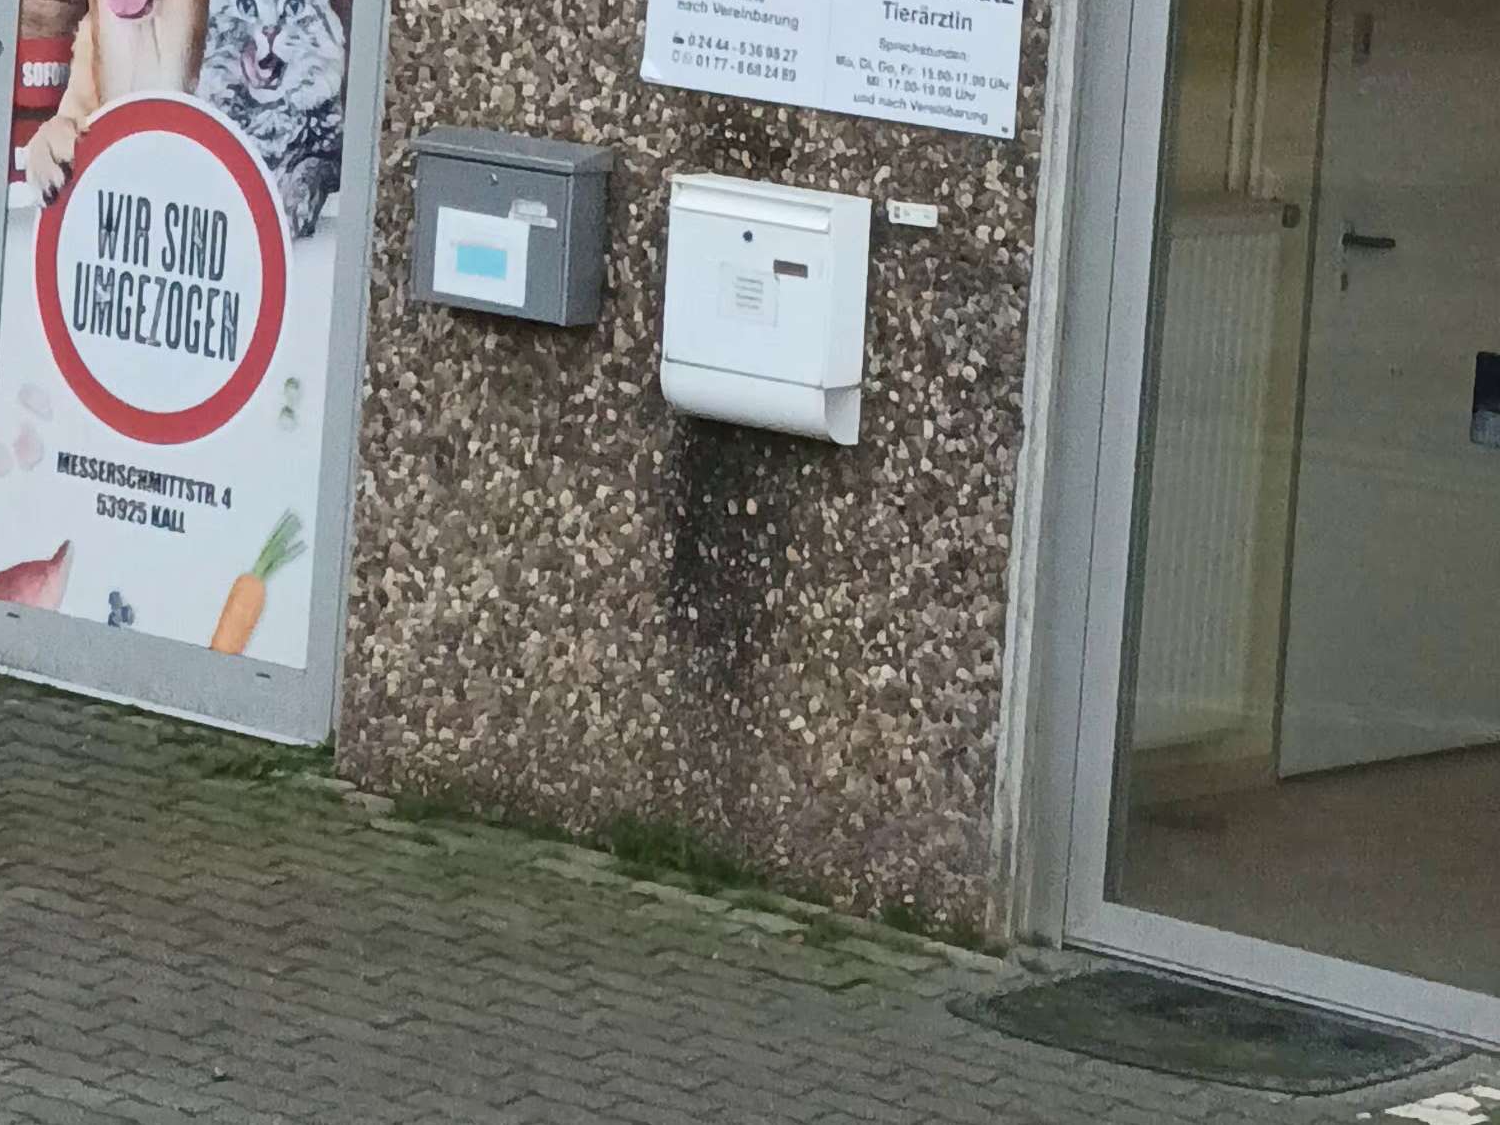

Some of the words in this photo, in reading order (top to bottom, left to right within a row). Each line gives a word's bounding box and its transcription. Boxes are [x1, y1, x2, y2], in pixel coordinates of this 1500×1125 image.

[677, 0, 708, 14] nach
[713, 2, 799, 31] Vereinbarung
[882, 0, 972, 31] Tierärztin
[956, 88, 976, 102] Uhr
[989, 77, 1010, 90] Uhr
[853, 93, 875, 106] und
[98, 189, 151, 268] WIR
[162, 202, 228, 281] SIND
[72, 261, 240, 363] UMGEZOGEN
[57, 451, 218, 507] MESSERSCHMITTSTR.
[221, 486, 232, 509] 4
[96, 492, 148, 525] 53925
[151, 504, 186, 533] KALL
